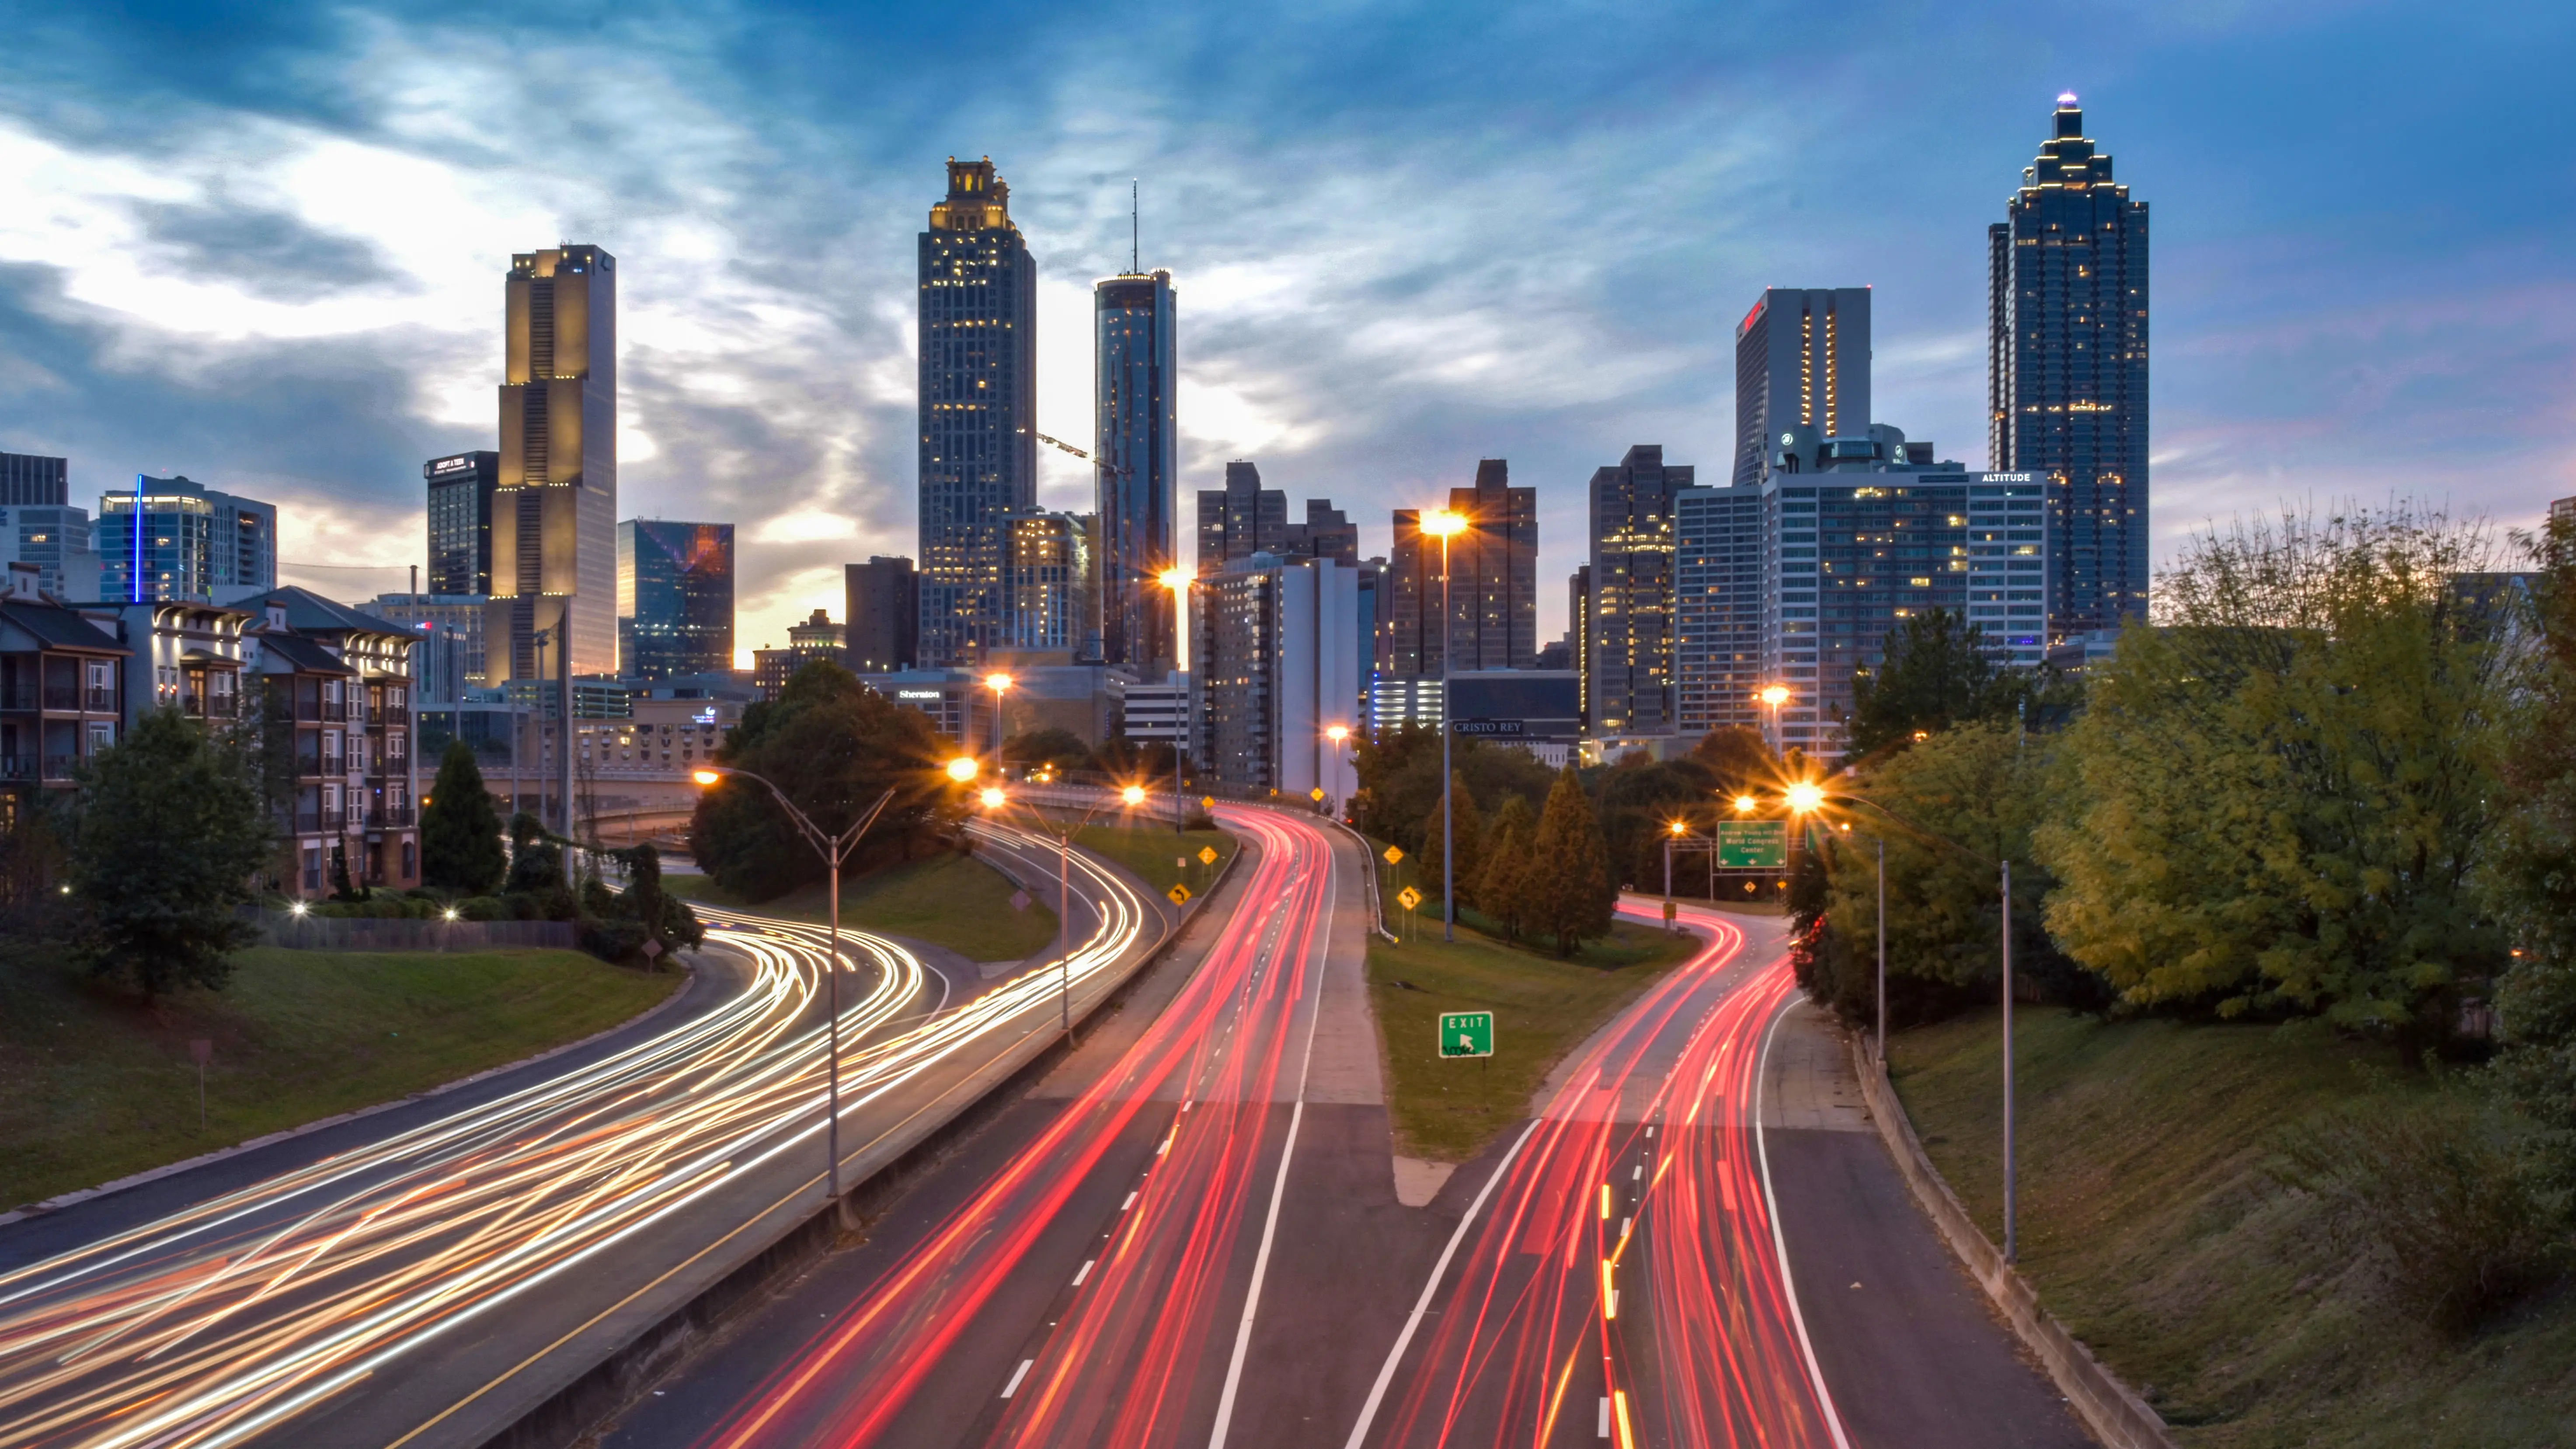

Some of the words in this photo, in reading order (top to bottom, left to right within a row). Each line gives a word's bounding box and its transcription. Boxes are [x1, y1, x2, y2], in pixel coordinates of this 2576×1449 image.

[1982, 474, 2031, 482] ALTITUDE
[1454, 723, 1496, 732] CRISTO
[1500, 722, 1521, 731] REY
[1449, 1017, 1483, 1028] EXIT
